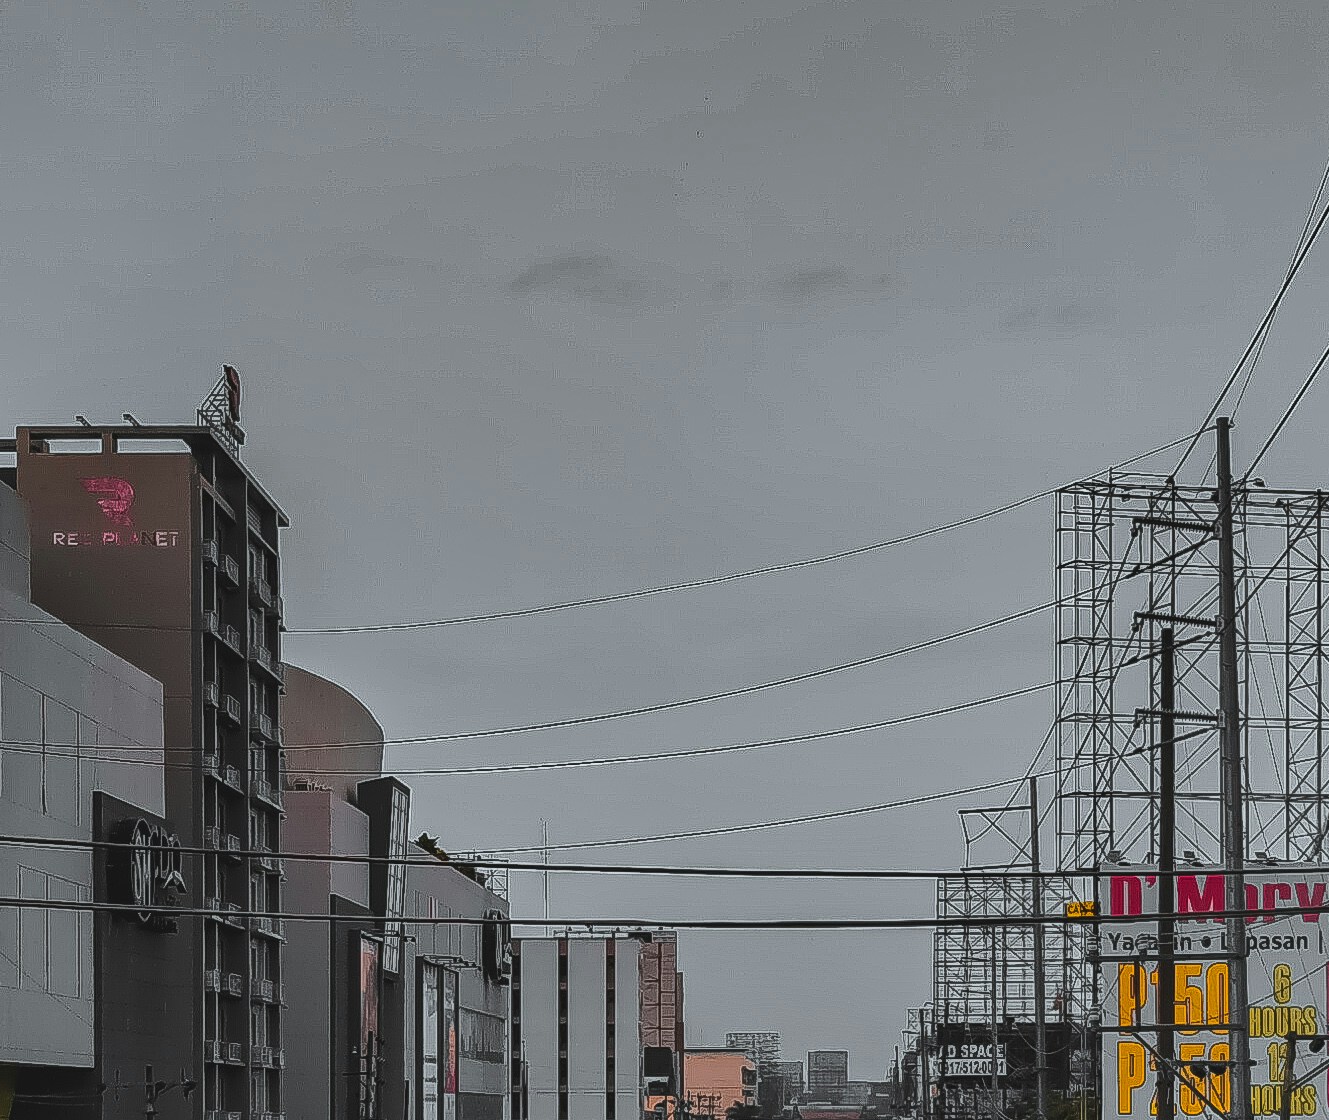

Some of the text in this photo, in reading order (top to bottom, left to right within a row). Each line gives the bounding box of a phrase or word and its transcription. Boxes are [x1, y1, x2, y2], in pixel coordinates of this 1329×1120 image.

[1220, 932, 1308, 956] Lpasan
[1273, 963, 1292, 1005] 6
[1249, 1006, 1318, 1038] HOURS
[960, 1044, 1004, 1058] SPACE
